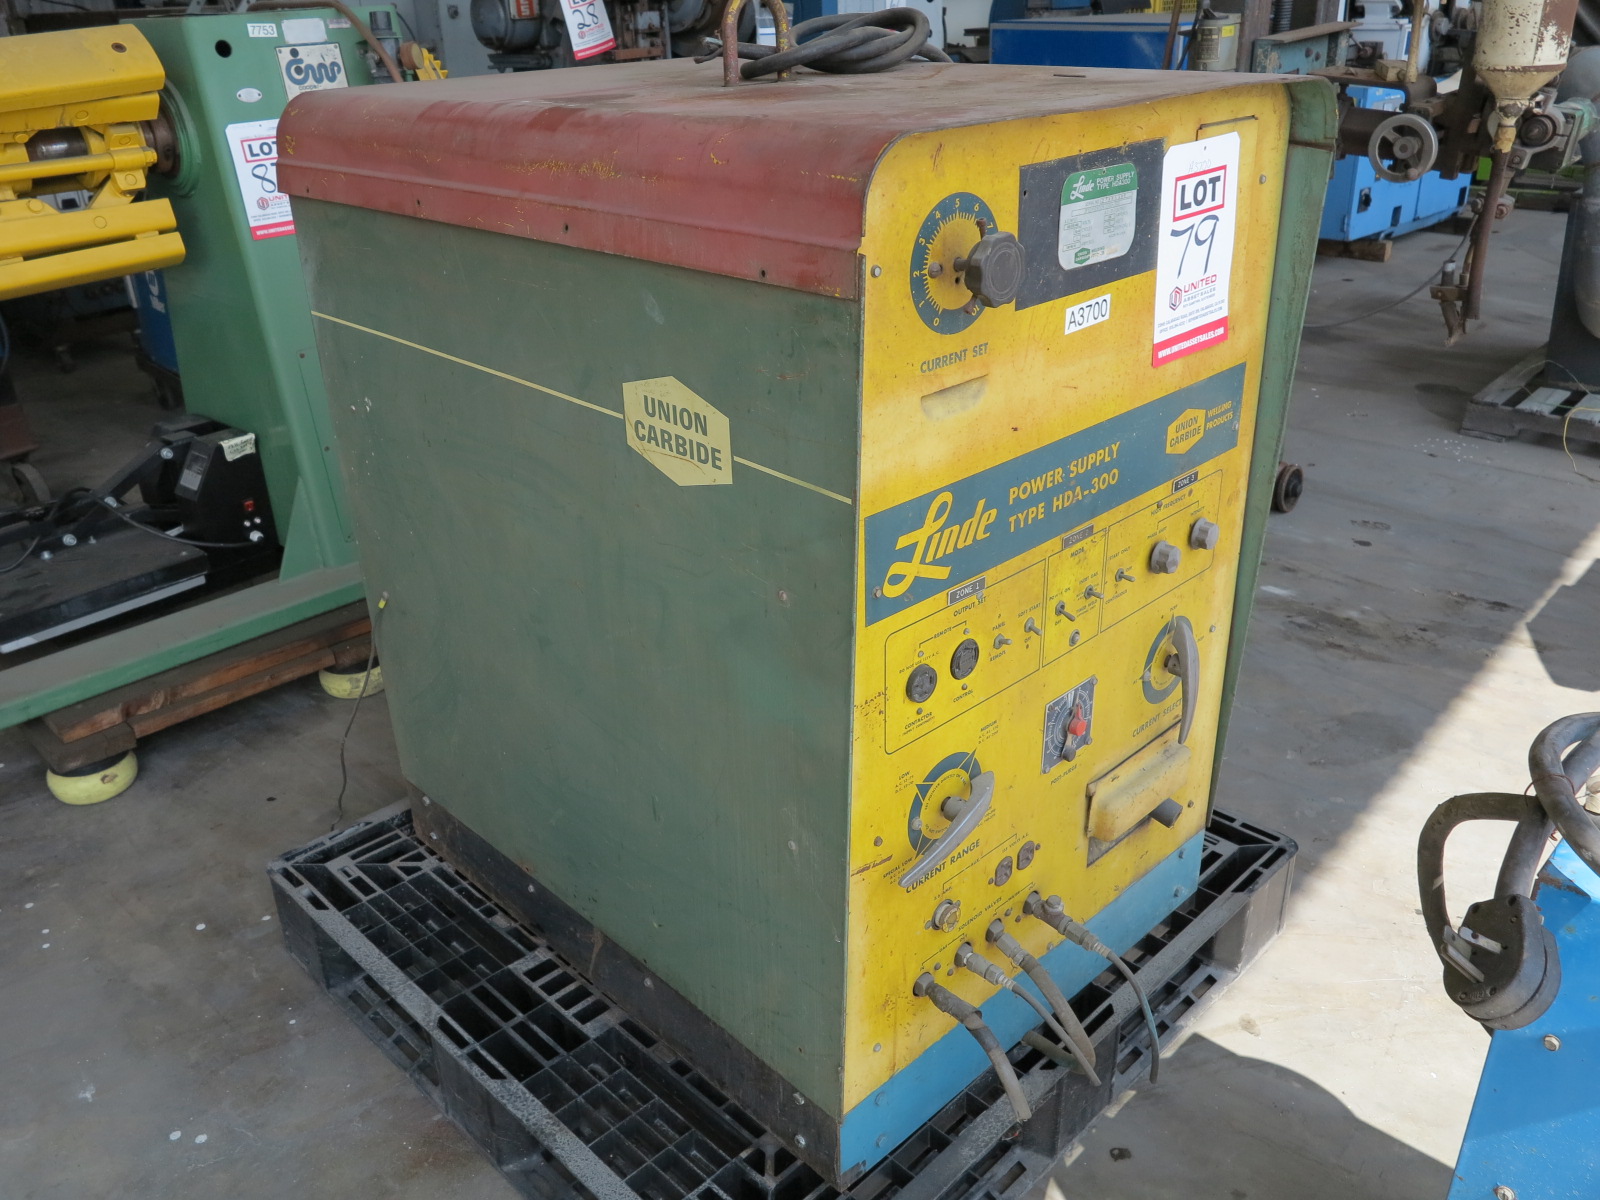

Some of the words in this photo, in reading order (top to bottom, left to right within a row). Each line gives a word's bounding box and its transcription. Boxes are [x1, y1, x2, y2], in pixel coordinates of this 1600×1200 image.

[572, 3, 599, 30] 28
[249, 25, 276, 36] 7753
[1069, 174, 1095, 200] Linde
[1096, 175, 1115, 186] POWER
[1116, 171, 1135, 181] SUPPLY
[1097, 182, 1110, 190] TYPE
[1180, 175, 1221, 211] LOT
[955, 198, 960, 208] 5
[973, 203, 980, 212] 6
[935, 210, 941, 219] 4
[918, 237, 926, 246] 3
[1170, 214, 1220, 279] 79
[1184, 274, 1217, 293] UNITED
[918, 300, 925, 308] 1
[933, 317, 940, 327] 0
[1067, 299, 1108, 331] A3700
[920, 348, 968, 374] CURRENT
[972, 342, 989, 358] SET
[643, 395, 708, 437] UNION
[1207, 400, 1233, 418] WELDING
[1175, 415, 1199, 433] UNION
[1206, 411, 1234, 430] PRODUCTS
[634, 419, 722, 471] CARBIDE
[1169, 425, 1202, 447] CARBIDE
[1008, 467, 1064, 505] POWER
[1069, 441, 1121, 479] SUPPLY
[1177, 476, 1190, 488] ZONE
[1008, 501, 1046, 533] TYPE
[1052, 468, 1120, 513] HDA-300
[1163, 494, 1186, 510] FREQUENCY
[882, 491, 999, 598] Linde
[1069, 532, 1083, 544] ZONE
[1070, 547, 1085, 558] MODE
[955, 584, 974, 599] ZONE
[975, 582, 980, 590] 1
[953, 602, 976, 617] OUTPUT
[977, 597, 986, 607] SET
[1017, 609, 1028, 618] SOFT
[1028, 602, 1041, 612] START
[934, 627, 952, 638] REMOTE
[992, 621, 1006, 631] PANEL
[989, 650, 1006, 662] REMOTE
[952, 689, 973, 703] CONTROL
[904, 711, 933, 730] CONTACTOR
[980, 720, 998, 732] MEDIUM
[1132, 714, 1161, 738] CURRENT
[898, 770, 910, 781] LOW
[1050, 764, 1078, 785] POST-PURGE
[883, 865, 900, 879] SPECIAL
[901, 857, 913, 867] LOW
[905, 861, 947, 894] CURRENT
[950, 838, 981, 865] RANGE
[958, 911, 983, 932] SOLENOID
[984, 896, 1002, 912] VALVES
